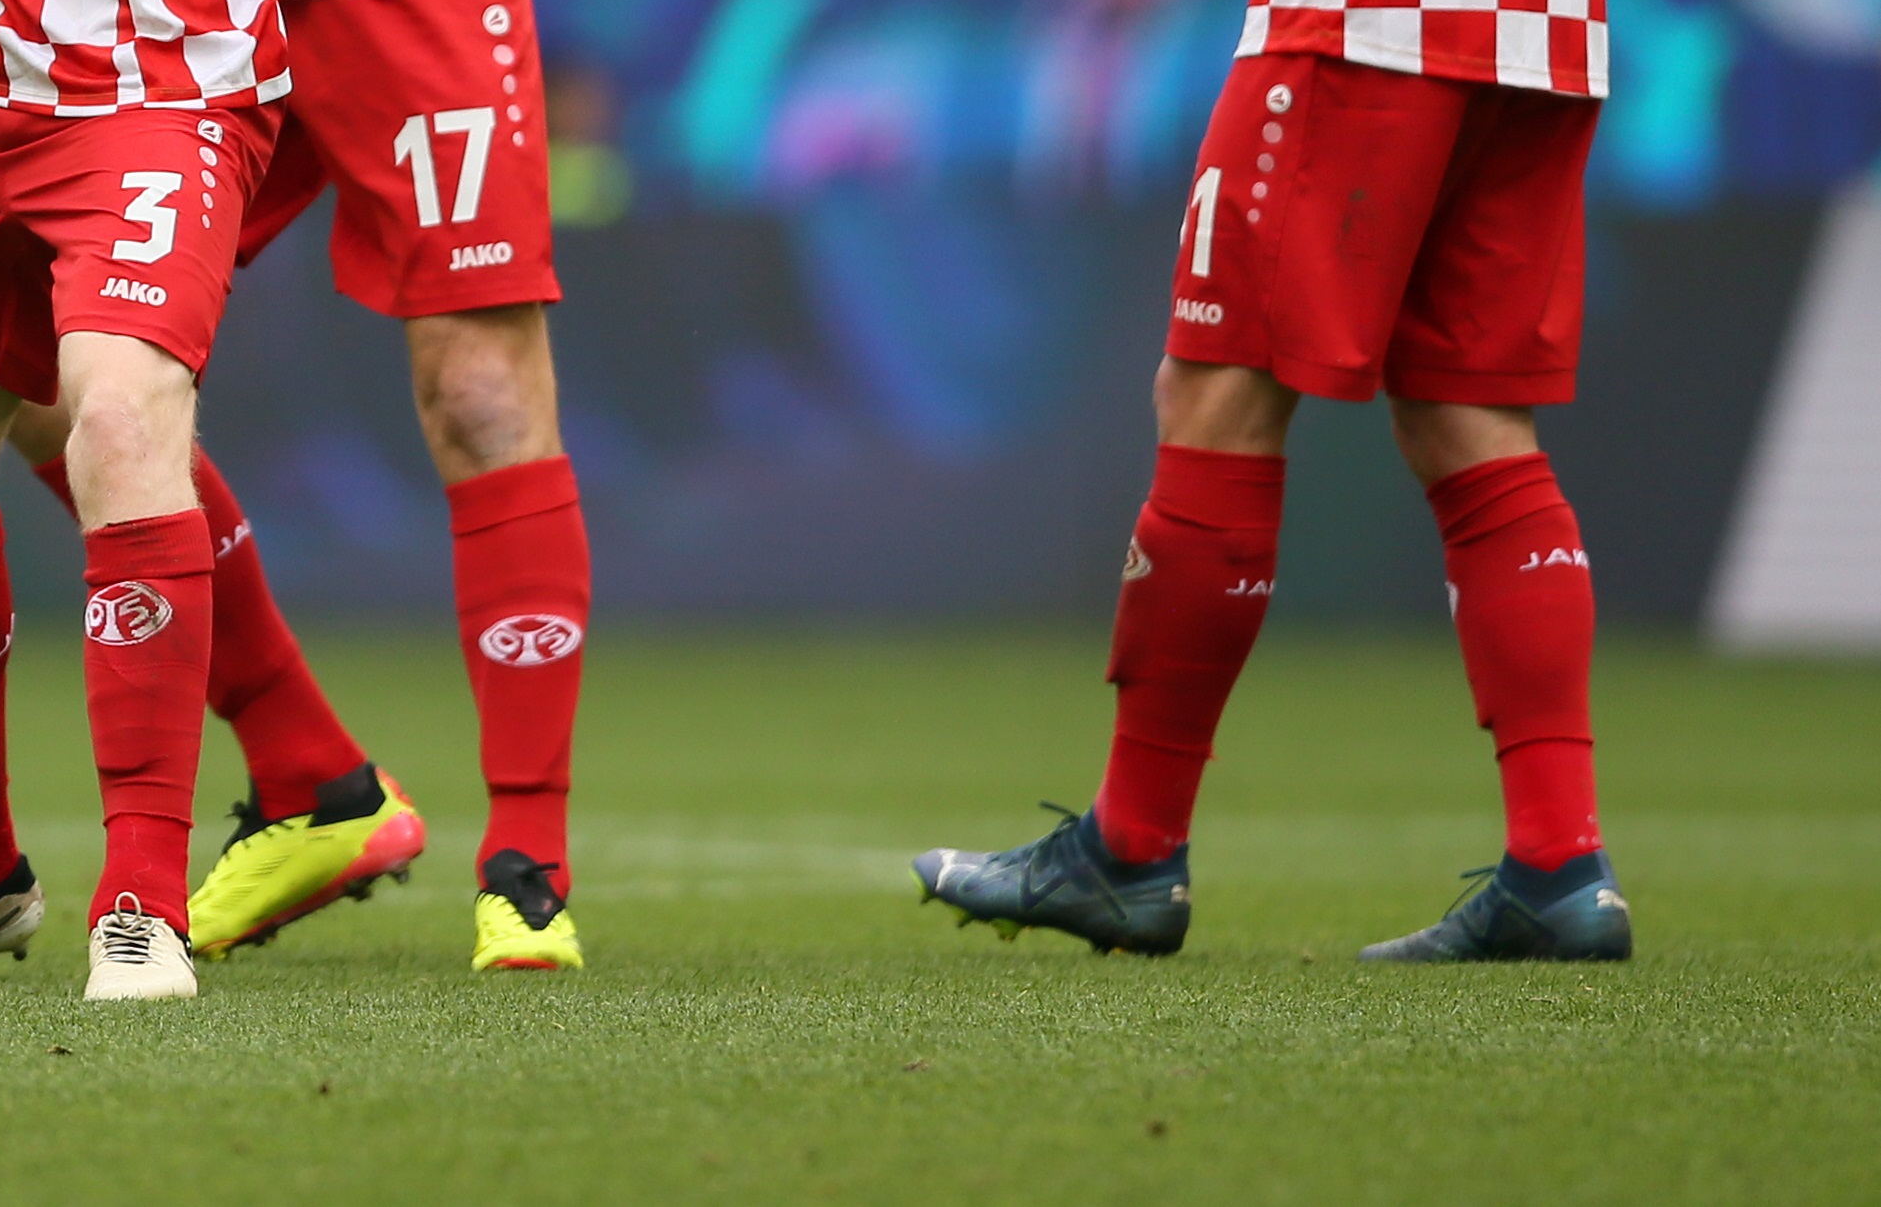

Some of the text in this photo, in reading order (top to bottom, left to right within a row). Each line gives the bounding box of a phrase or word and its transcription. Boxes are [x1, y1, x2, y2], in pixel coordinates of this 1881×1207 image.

[393, 107, 496, 228] 17
[111, 171, 184, 264] 3
[449, 241, 514, 272] JAKO
[100, 277, 168, 307] JAKO
